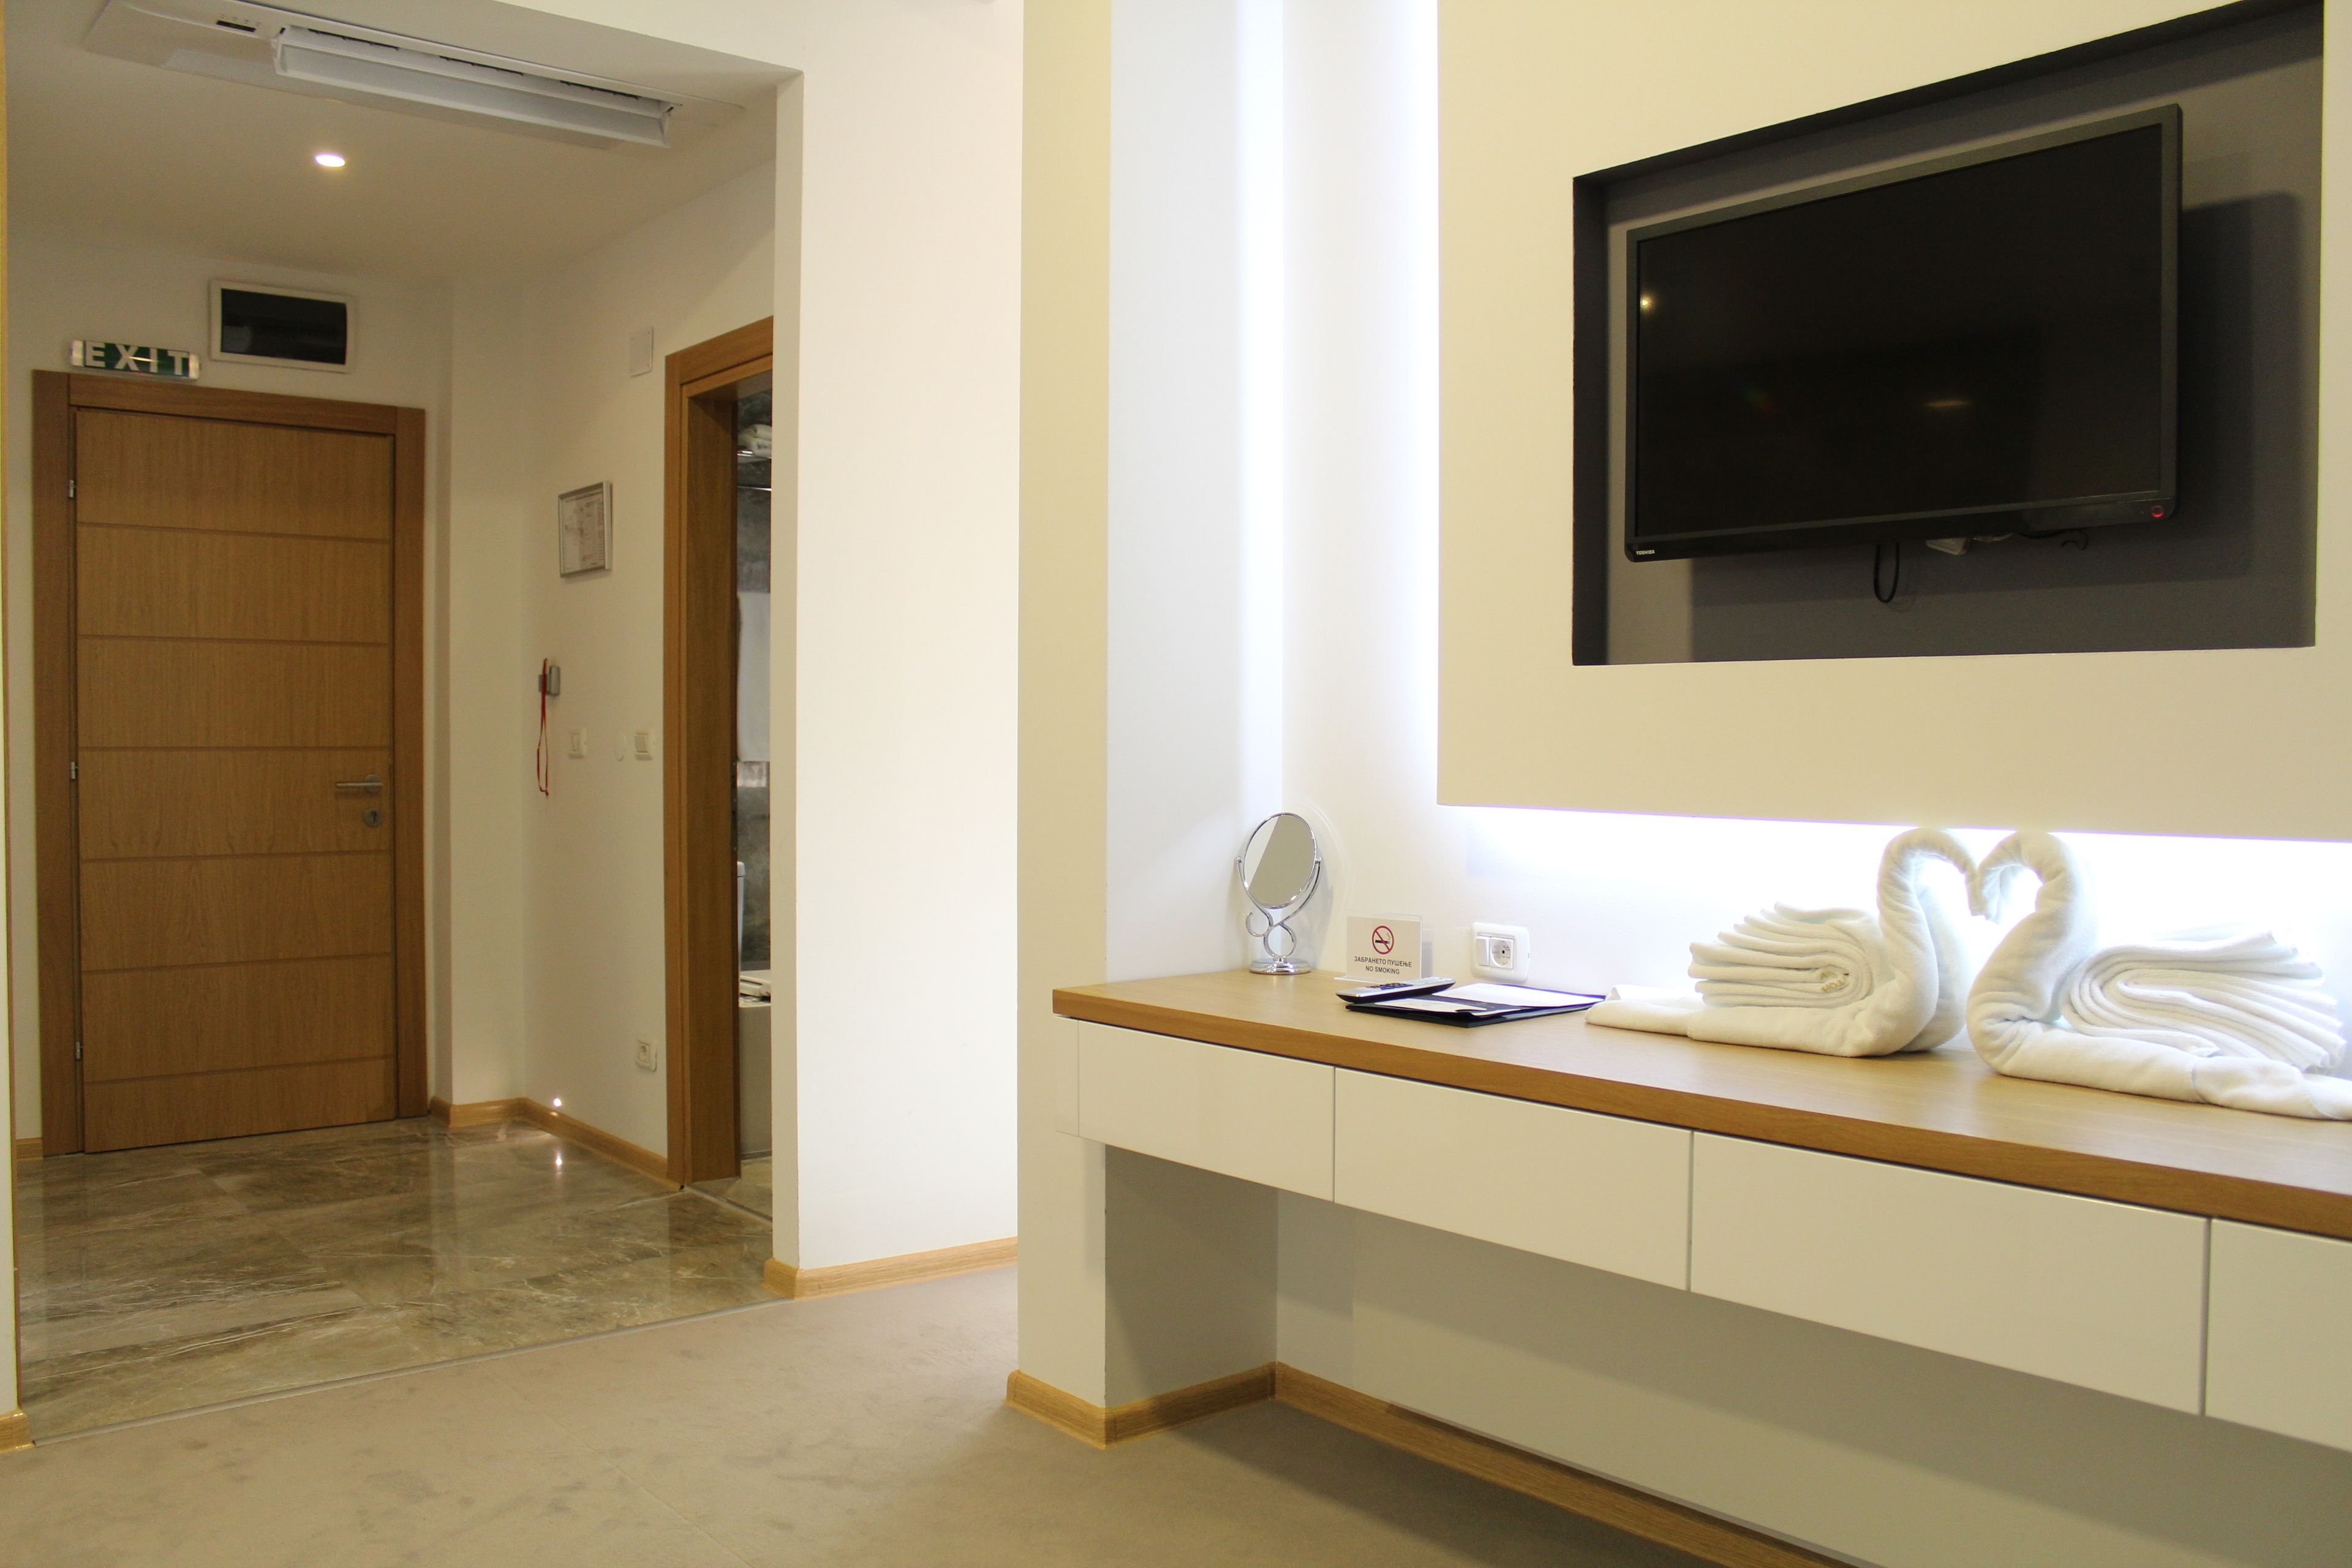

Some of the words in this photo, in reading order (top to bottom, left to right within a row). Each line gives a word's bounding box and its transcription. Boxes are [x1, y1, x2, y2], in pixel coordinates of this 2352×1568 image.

[85, 340, 189, 375] EXIT
[1354, 956, 1387, 965] ЗАБРАНЕТО
[1387, 959, 1412, 968] ПУШЕЊЕ
[1374, 967, 1400, 975] SMOKING
